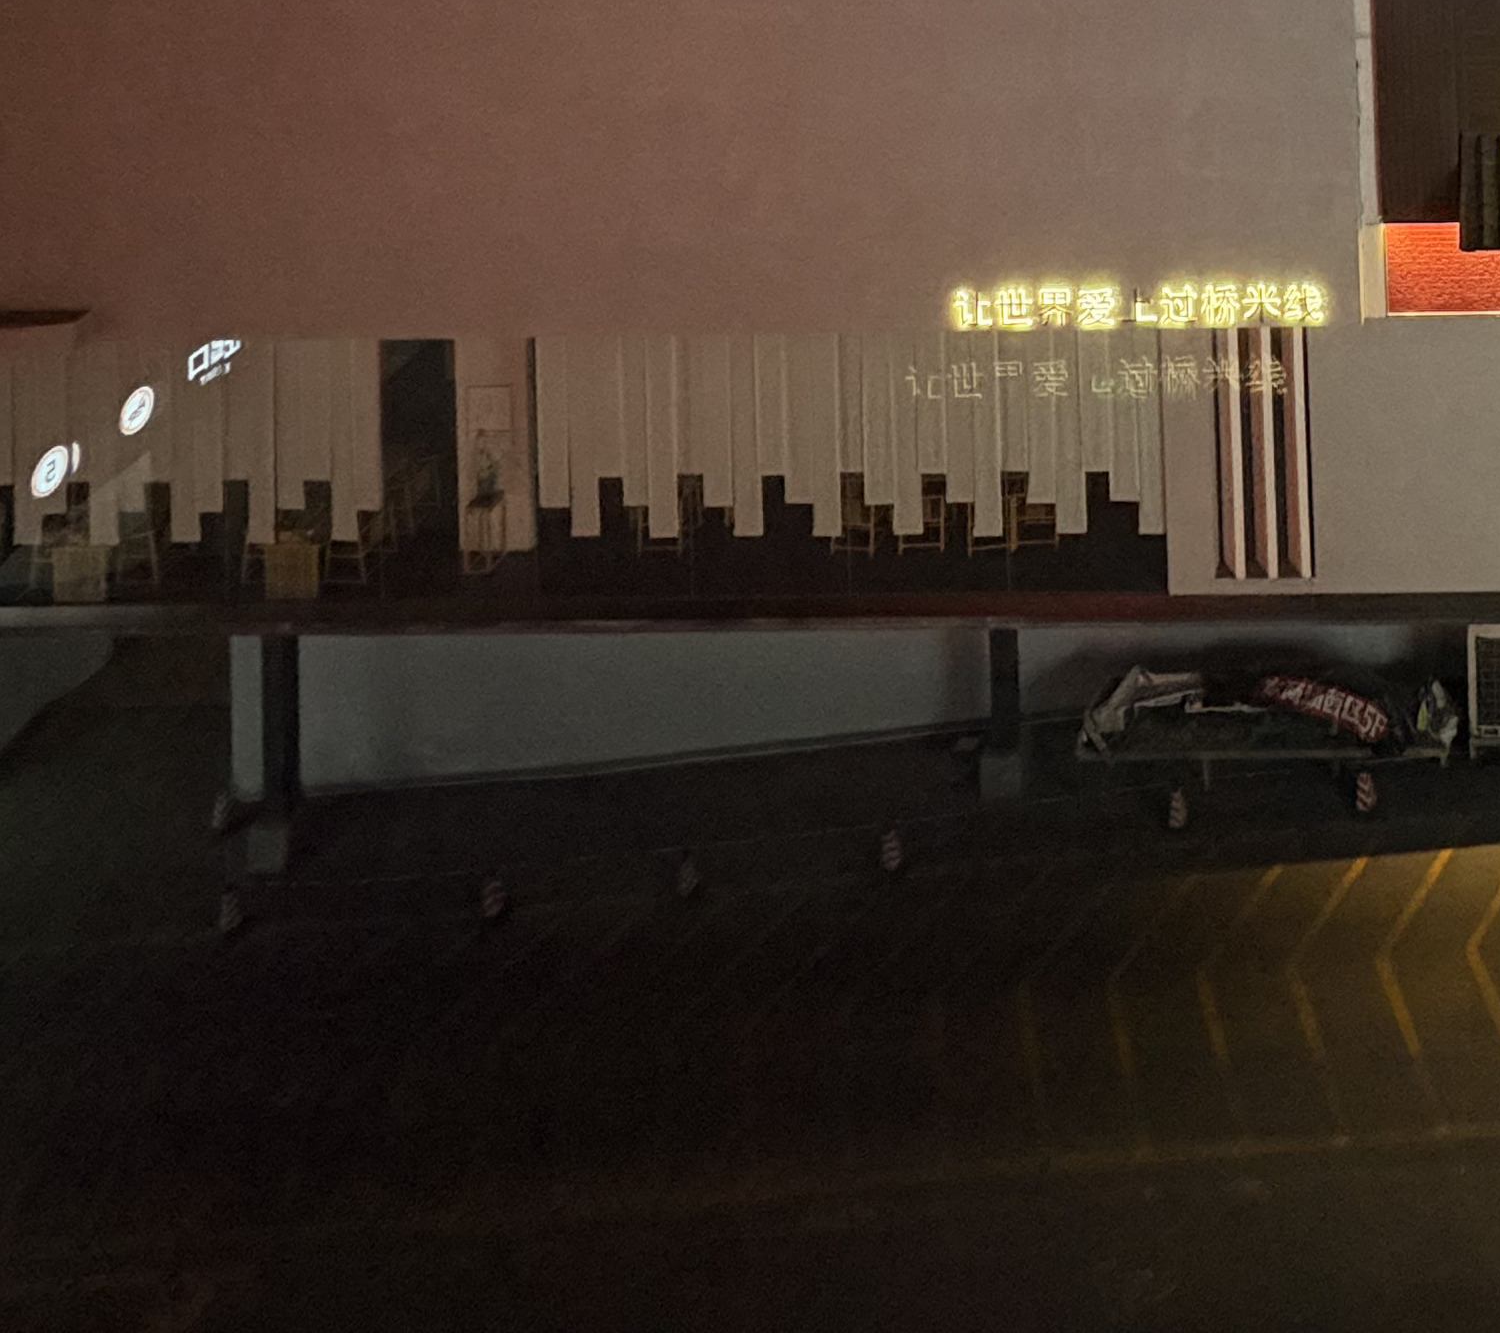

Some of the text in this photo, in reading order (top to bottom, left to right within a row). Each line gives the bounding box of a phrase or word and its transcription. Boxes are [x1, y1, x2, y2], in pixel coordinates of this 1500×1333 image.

[953, 282, 1326, 329] 让世界爱上过桥米线
